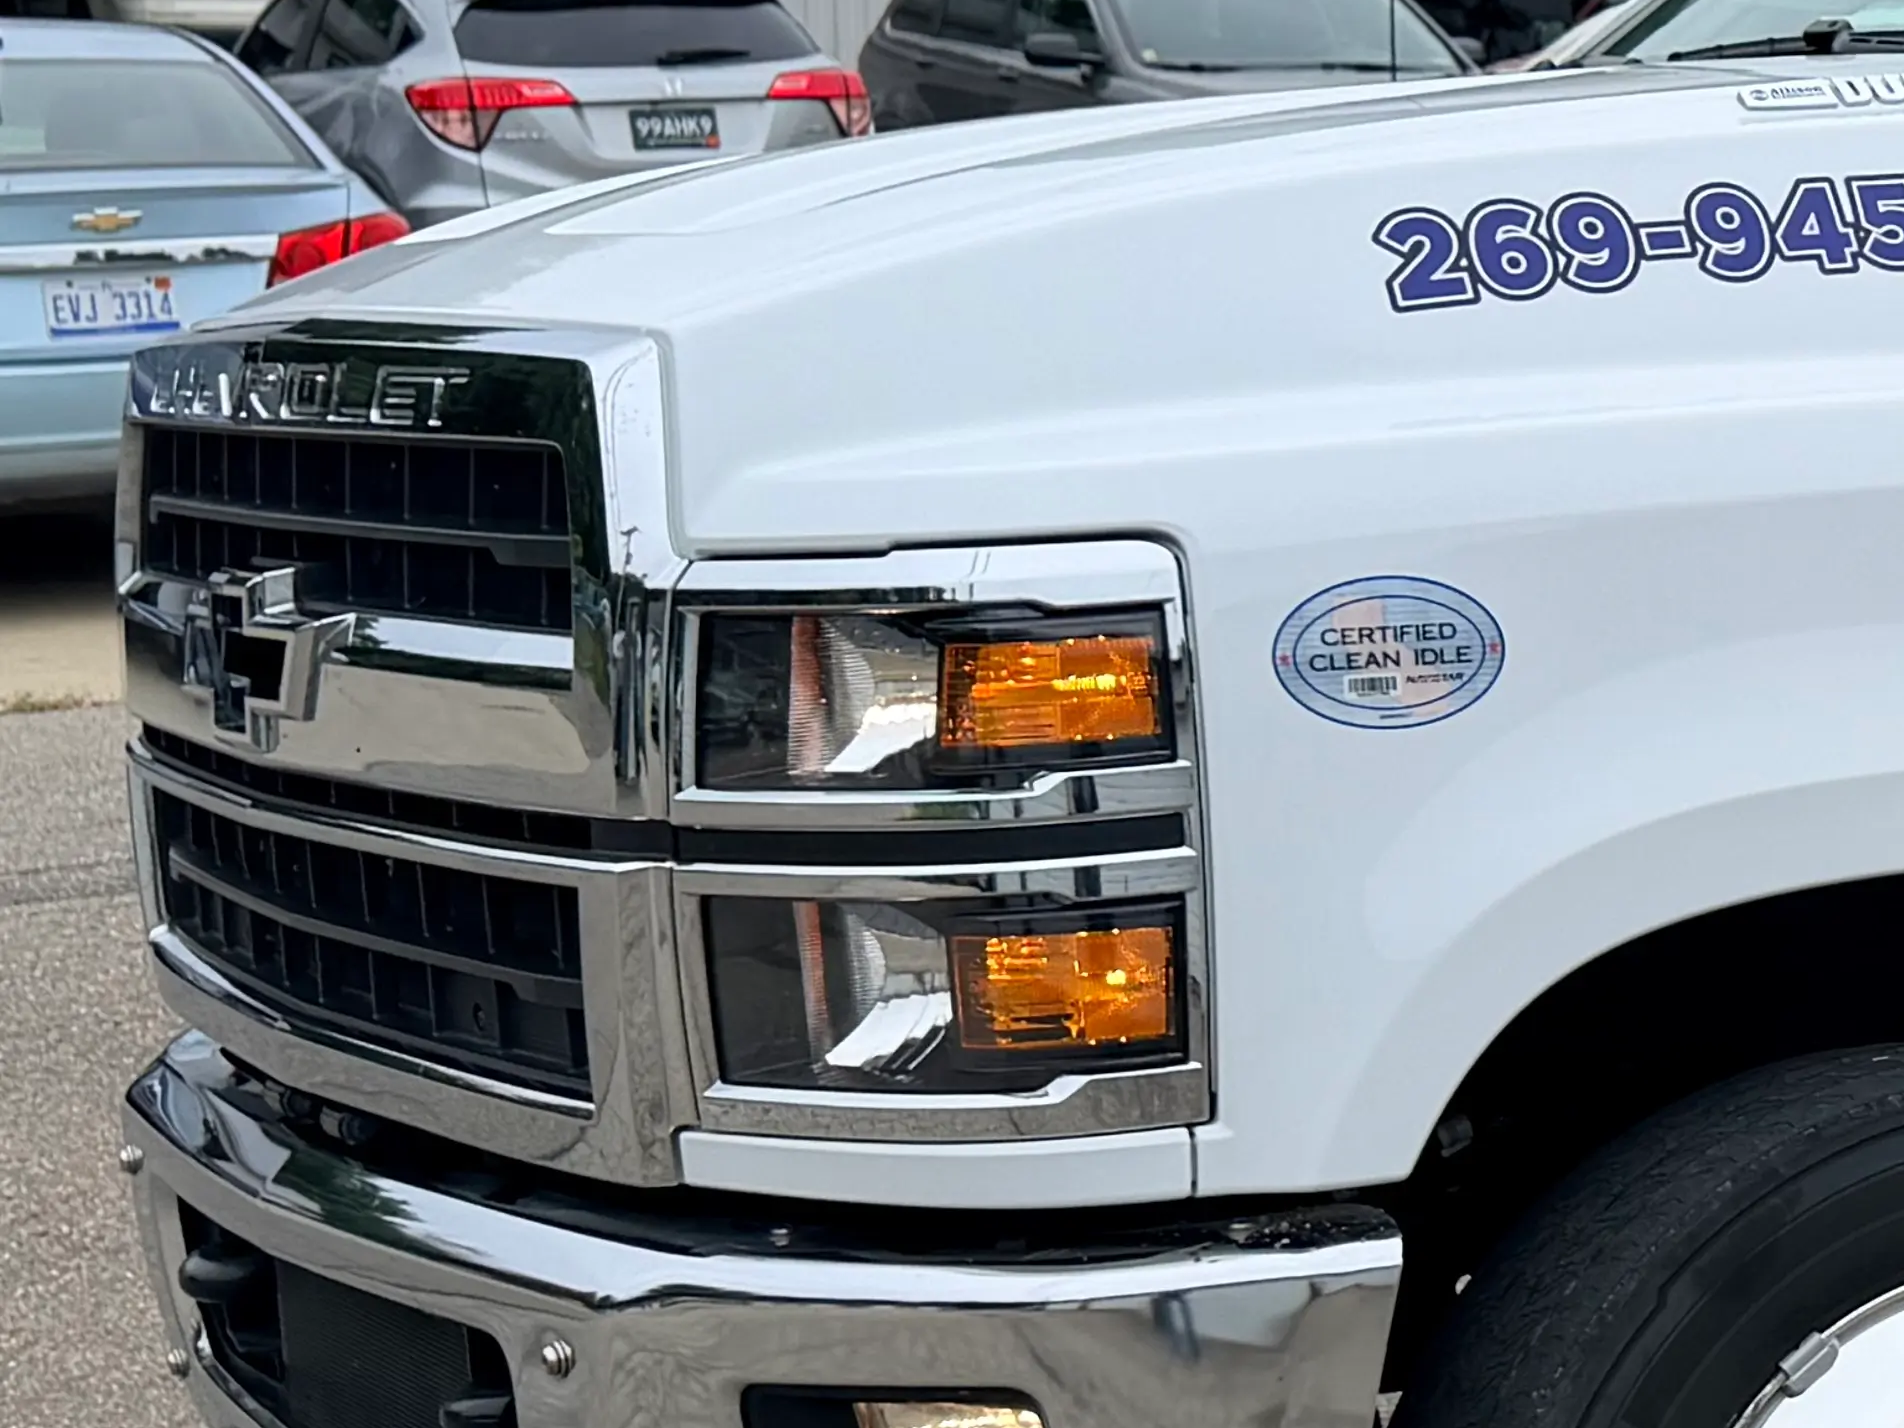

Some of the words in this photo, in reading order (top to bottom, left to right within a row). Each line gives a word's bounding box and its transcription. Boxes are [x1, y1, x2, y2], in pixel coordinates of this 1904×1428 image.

[635, 114, 713, 139] 99AHK9
[52, 292, 98, 324] EVJ
[112, 290, 173, 322] 3314
[1319, 621, 1458, 647] CERTIFIED
[1308, 649, 1402, 673] CLEAN
[1413, 645, 1474, 667] IDLE
